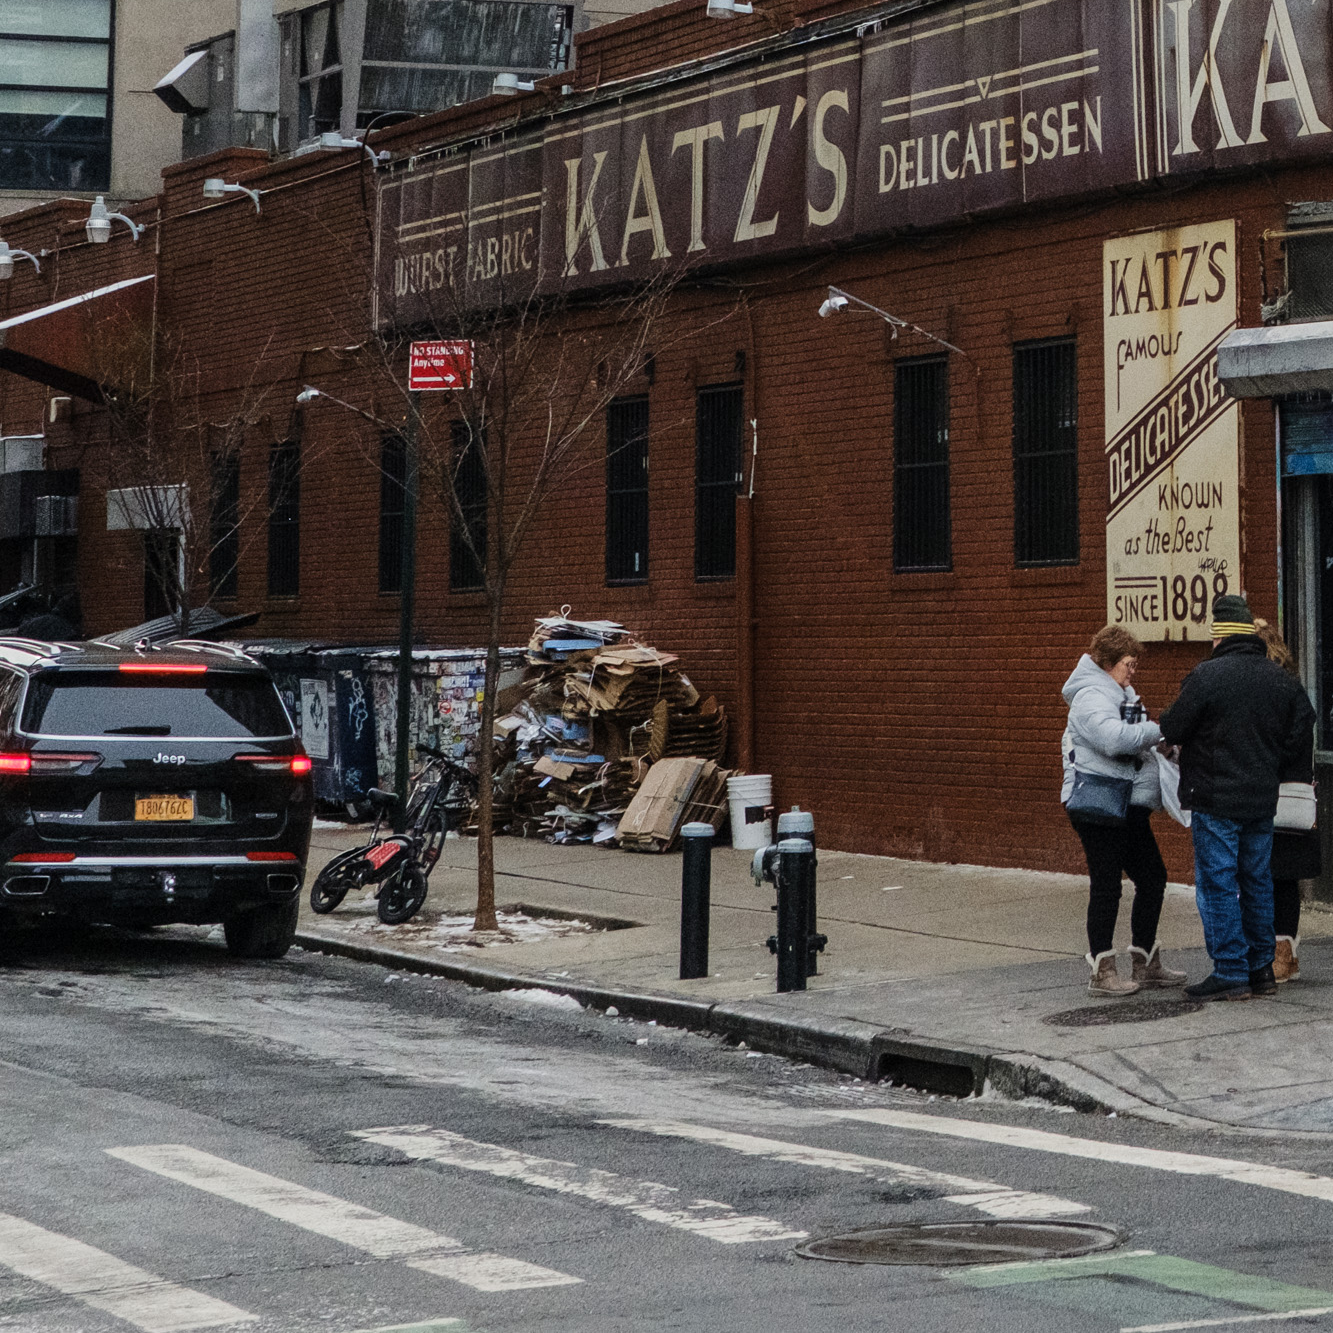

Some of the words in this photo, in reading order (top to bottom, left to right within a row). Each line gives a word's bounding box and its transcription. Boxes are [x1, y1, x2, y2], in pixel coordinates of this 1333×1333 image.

[878, 95, 1103, 195] DELICATESSEN
[561, 88, 850, 278] KATZ'S
[1109, 240, 1228, 317] KATZ'S
[413, 346, 425, 356] NO
[426, 345, 465, 356] STANDING
[1158, 481, 1223, 512] KNOWN
[1124, 536, 1141, 555] as
[1145, 517, 1170, 555] the
[1171, 515, 1213, 554] Best
[1115, 594, 1159, 623] SINCE
[152, 752, 186, 765] Jeep
[140, 799, 188, 816] T806762C
